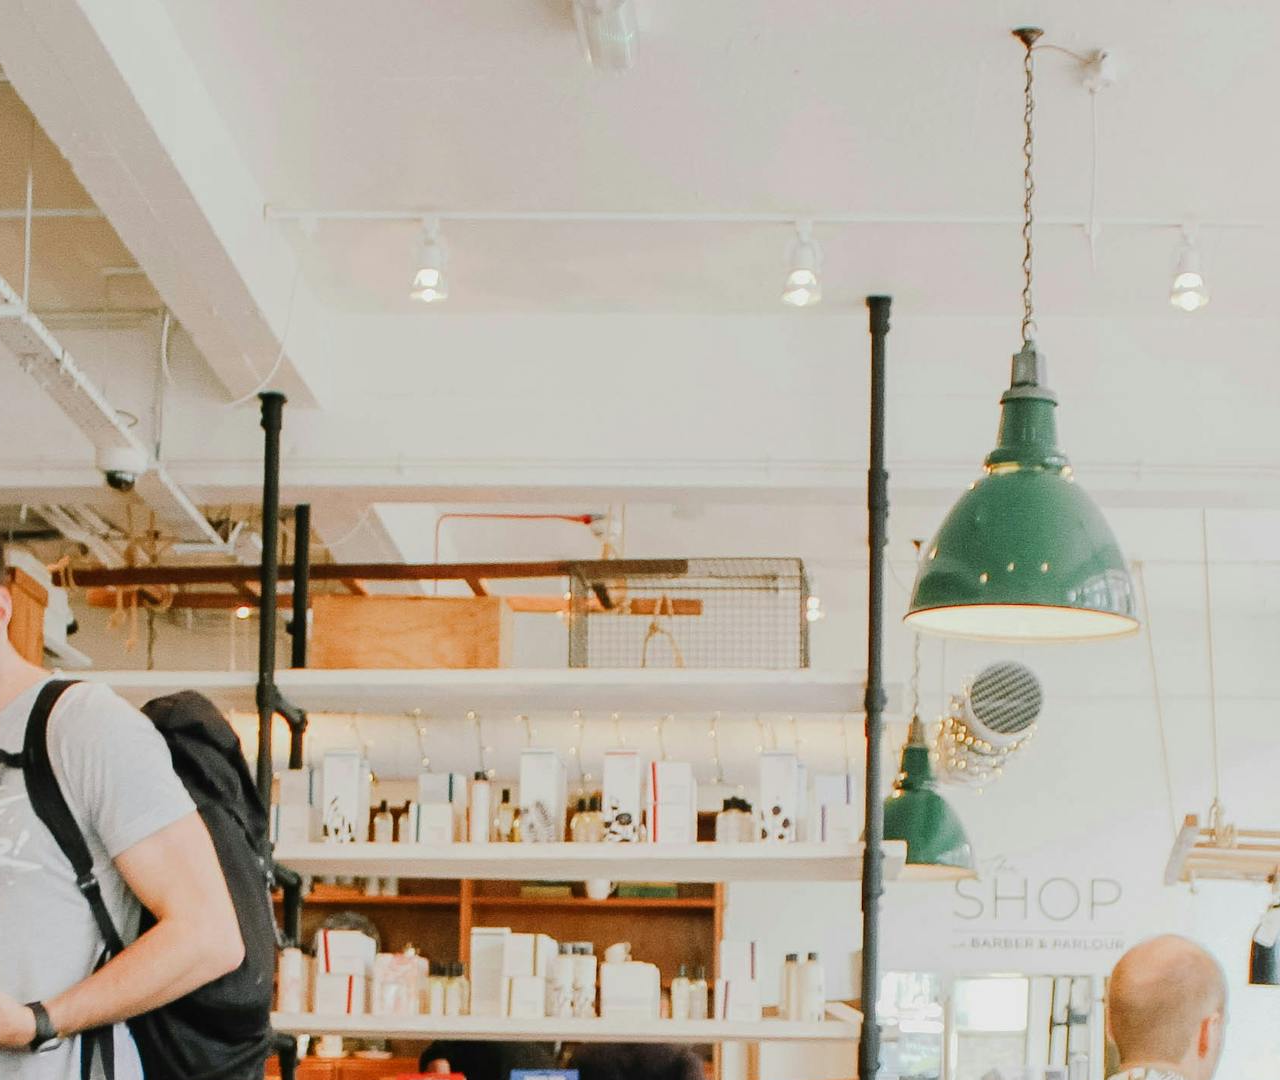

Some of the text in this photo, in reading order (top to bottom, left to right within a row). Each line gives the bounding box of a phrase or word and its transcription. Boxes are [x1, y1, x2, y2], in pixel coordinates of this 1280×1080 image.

[953, 876, 1123, 922] SHOP
[970, 936, 1034, 950] BARBER
[1052, 936, 1125, 951] PARLOUR
